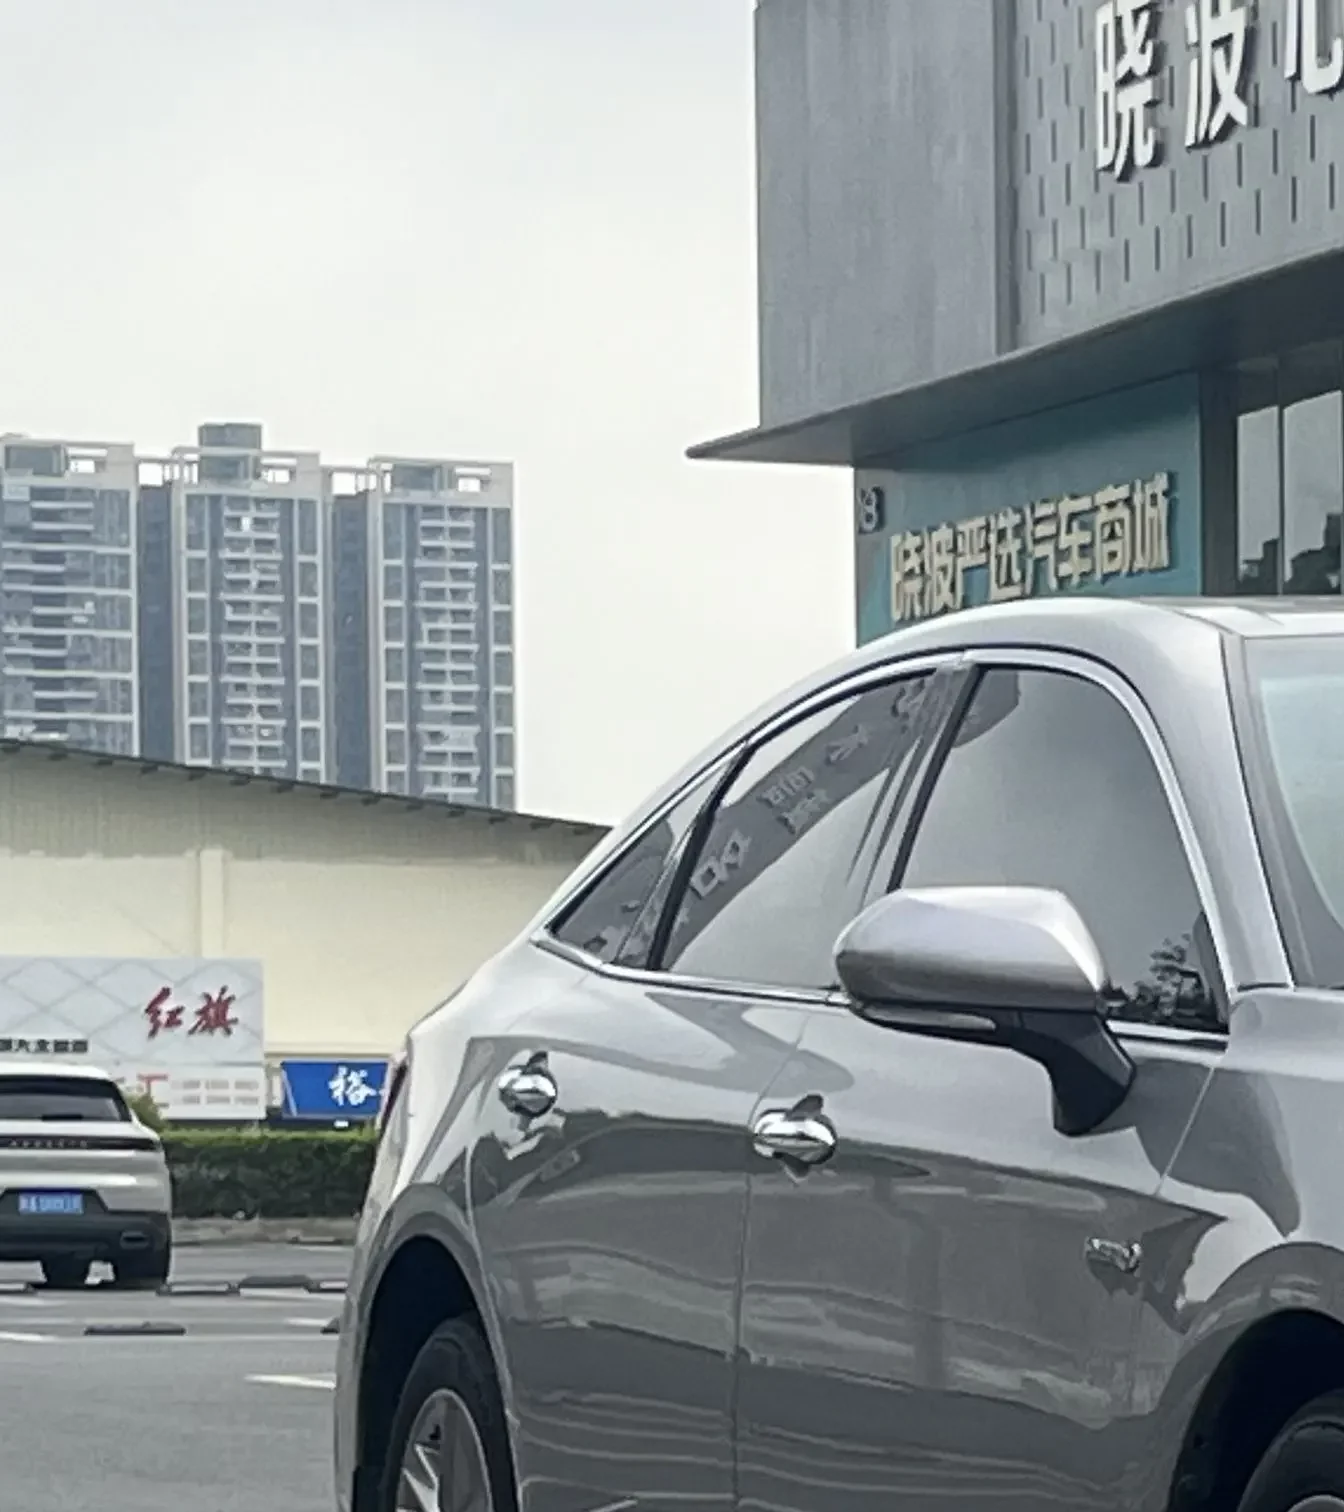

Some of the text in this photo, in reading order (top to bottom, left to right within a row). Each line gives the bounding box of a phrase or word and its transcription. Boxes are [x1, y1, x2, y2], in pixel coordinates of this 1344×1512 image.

[889, 470, 1171, 621] 晓波严选汽车商城
[144, 986, 239, 1038] 红旗
